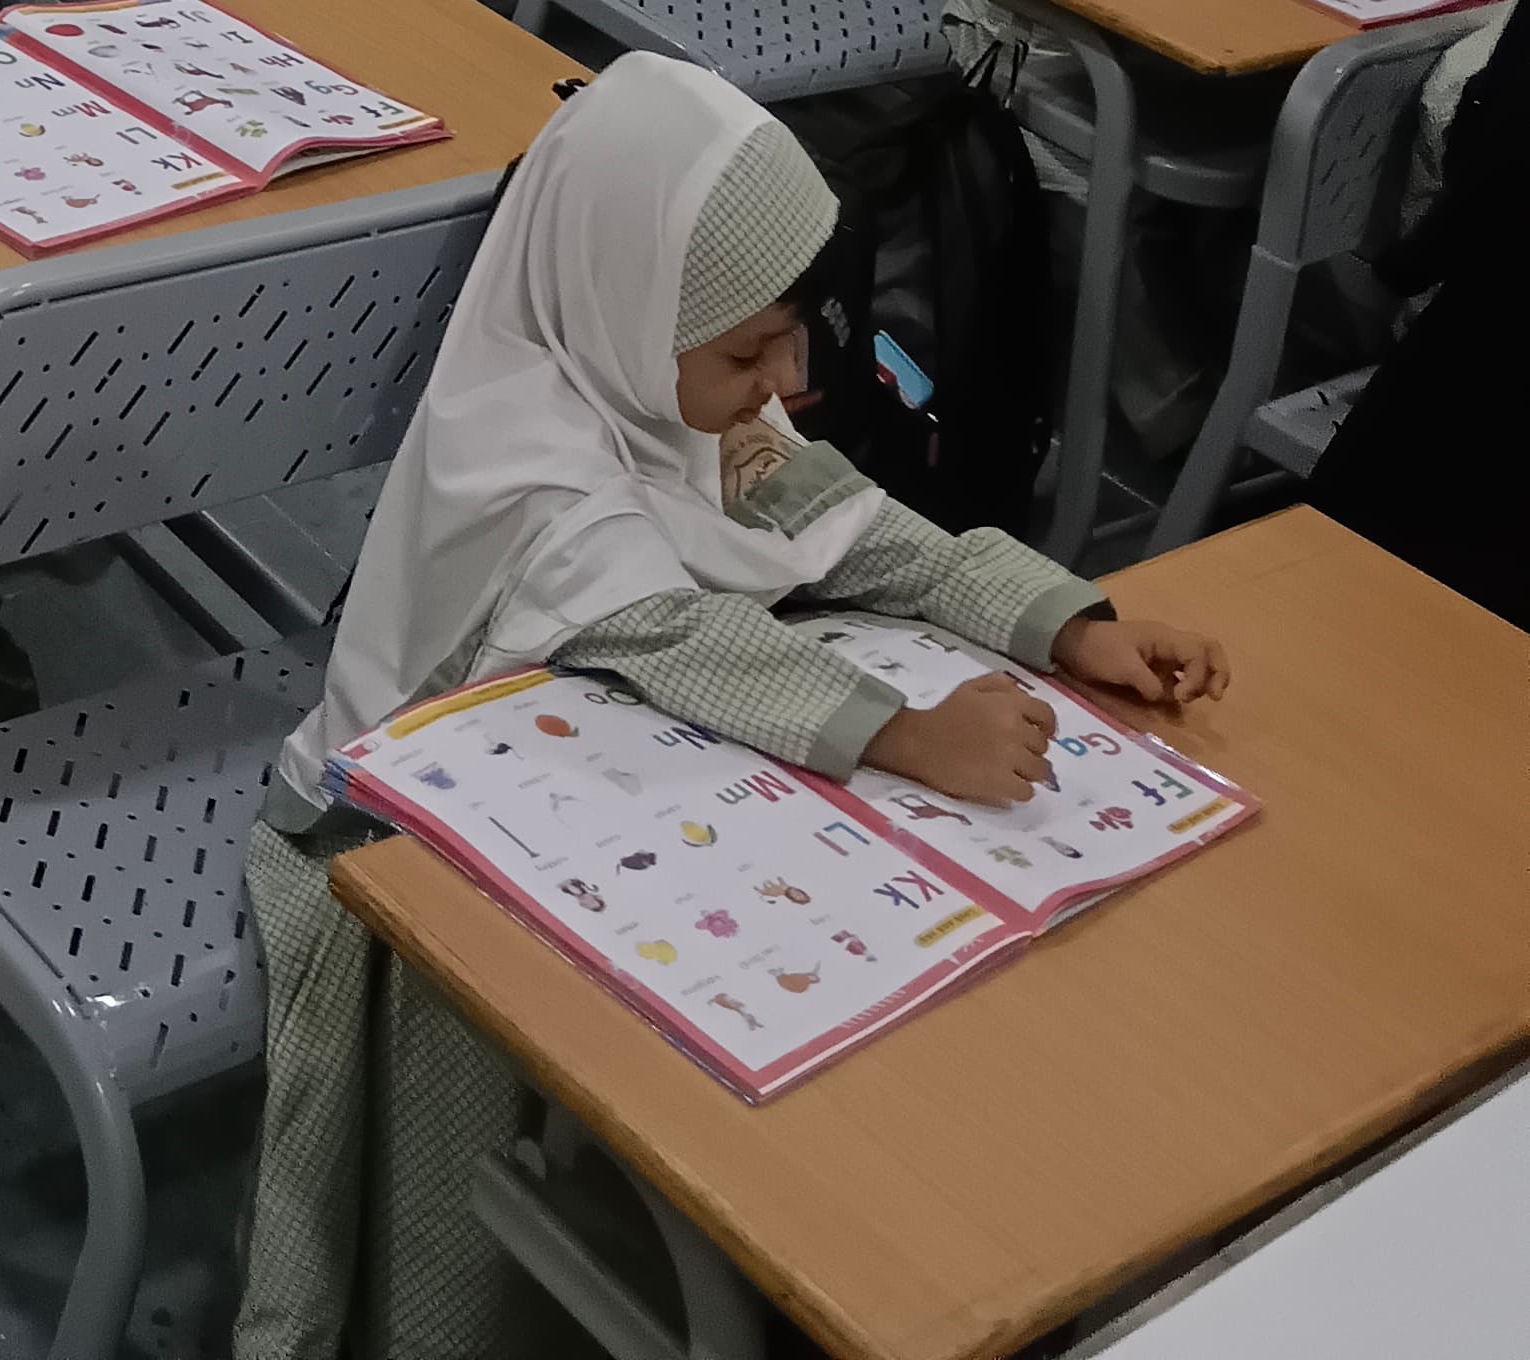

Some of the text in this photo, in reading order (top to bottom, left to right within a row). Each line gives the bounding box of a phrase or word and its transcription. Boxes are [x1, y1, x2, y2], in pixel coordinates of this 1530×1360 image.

[258, 53, 304, 68] Hh
[14, 73, 65, 91] Nn
[51, 100, 111, 118] Mm
[360, 101, 404, 118] Ff
[151, 152, 203, 172] Kk
[583, 687, 642, 706] Oo
[653, 720, 721, 750] Nn
[716, 770, 796, 805] Mm
[1133, 769, 1194, 806] Ff
[813, 821, 870, 856] Ll
[874, 869, 944, 909] Kk
